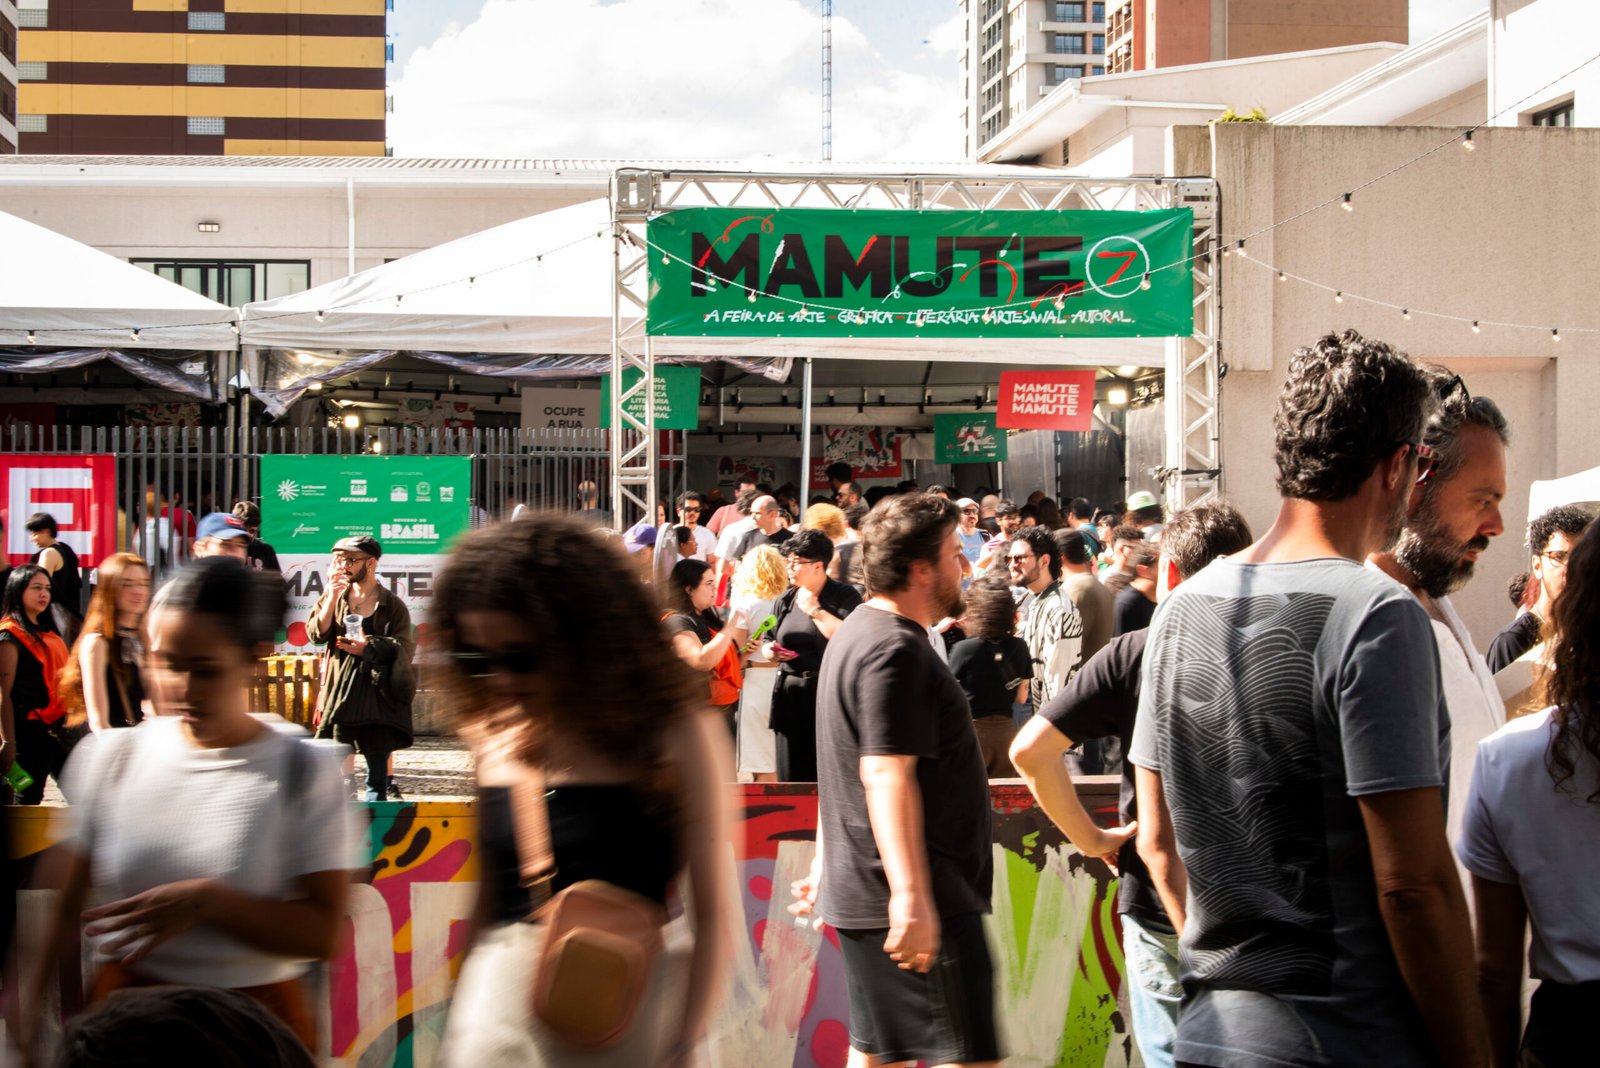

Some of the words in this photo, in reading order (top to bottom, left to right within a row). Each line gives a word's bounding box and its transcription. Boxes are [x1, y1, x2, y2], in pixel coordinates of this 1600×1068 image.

[691, 232, 1083, 298] MAMUTE
[1097, 250, 1138, 287] 7
[703, 309, 719, 323] A
[722, 309, 766, 323] FEIRA
[767, 310, 785, 323] DE
[788, 310, 826, 323] ARTE
[1013, 383, 1081, 394] MAMUTE
[1012, 393, 1080, 405] MAMUTE
[543, 406, 585, 417] OCUPE
[1011, 403, 1078, 416] MAMUTE
[547, 419, 556, 428] A
[558, 419, 583, 429] RUA
[7, 468, 93, 555] E
[380, 523, 440, 539] BRASIL
[284, 570, 433, 597] MATE
